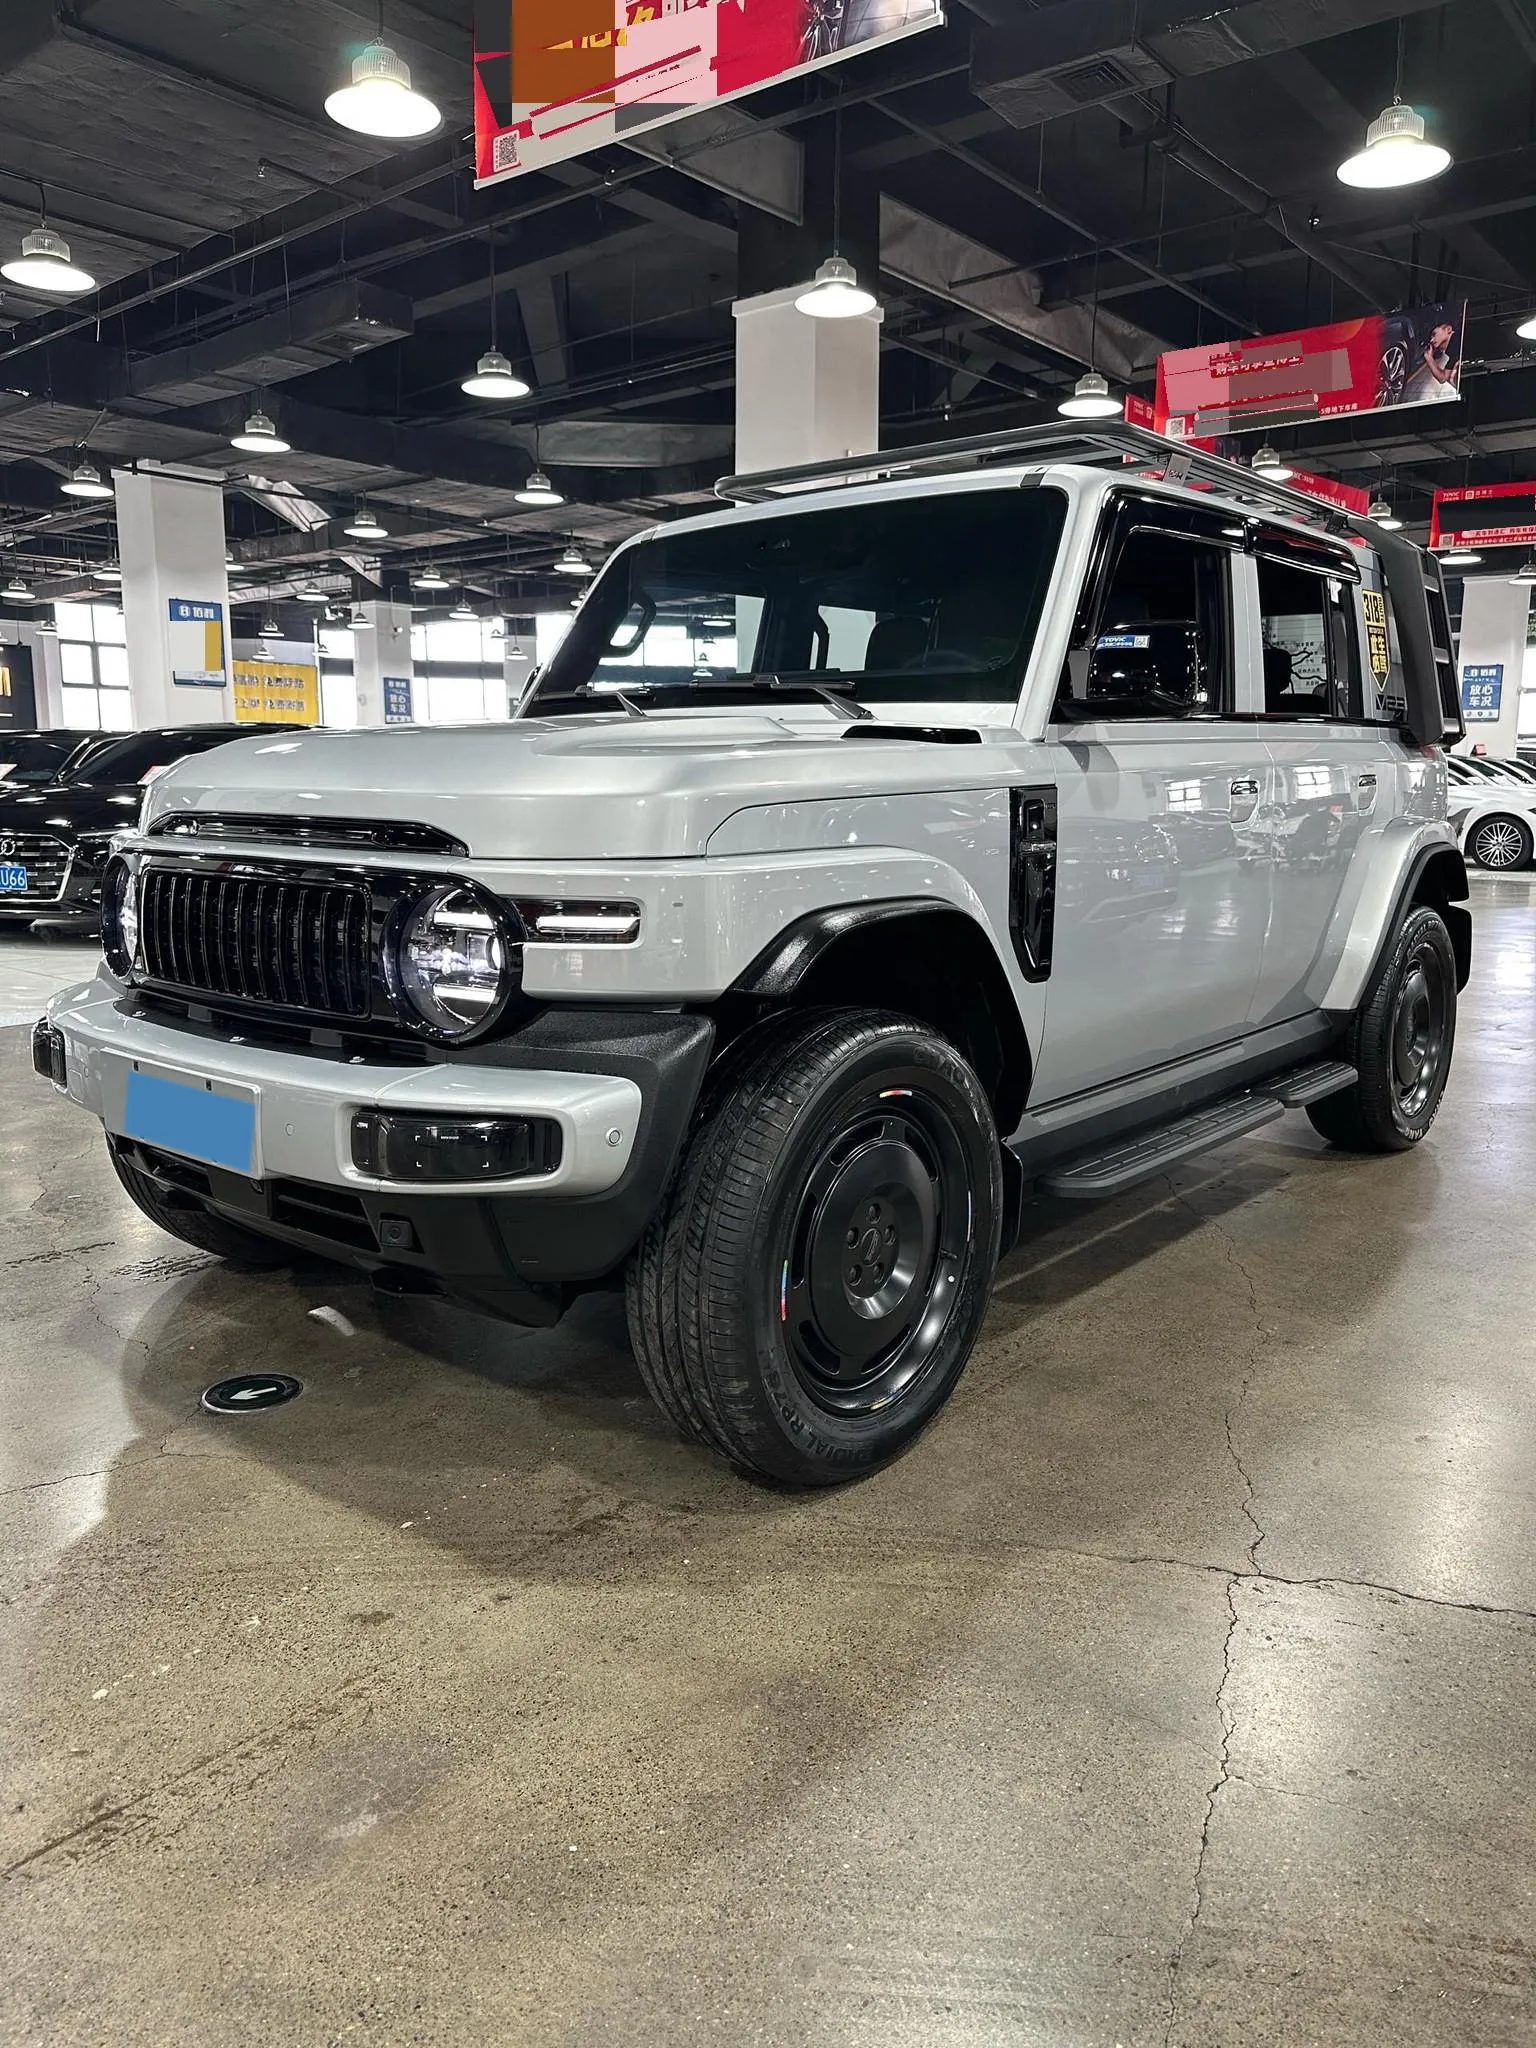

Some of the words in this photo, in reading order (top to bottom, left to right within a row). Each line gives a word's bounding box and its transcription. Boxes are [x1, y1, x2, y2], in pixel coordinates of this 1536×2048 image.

[1363, 594, 1380, 623] 318
[1470, 684, 1493, 696] 放心
[1468, 695, 1493, 707] 车况
[0, 870, 25, 887] U66
